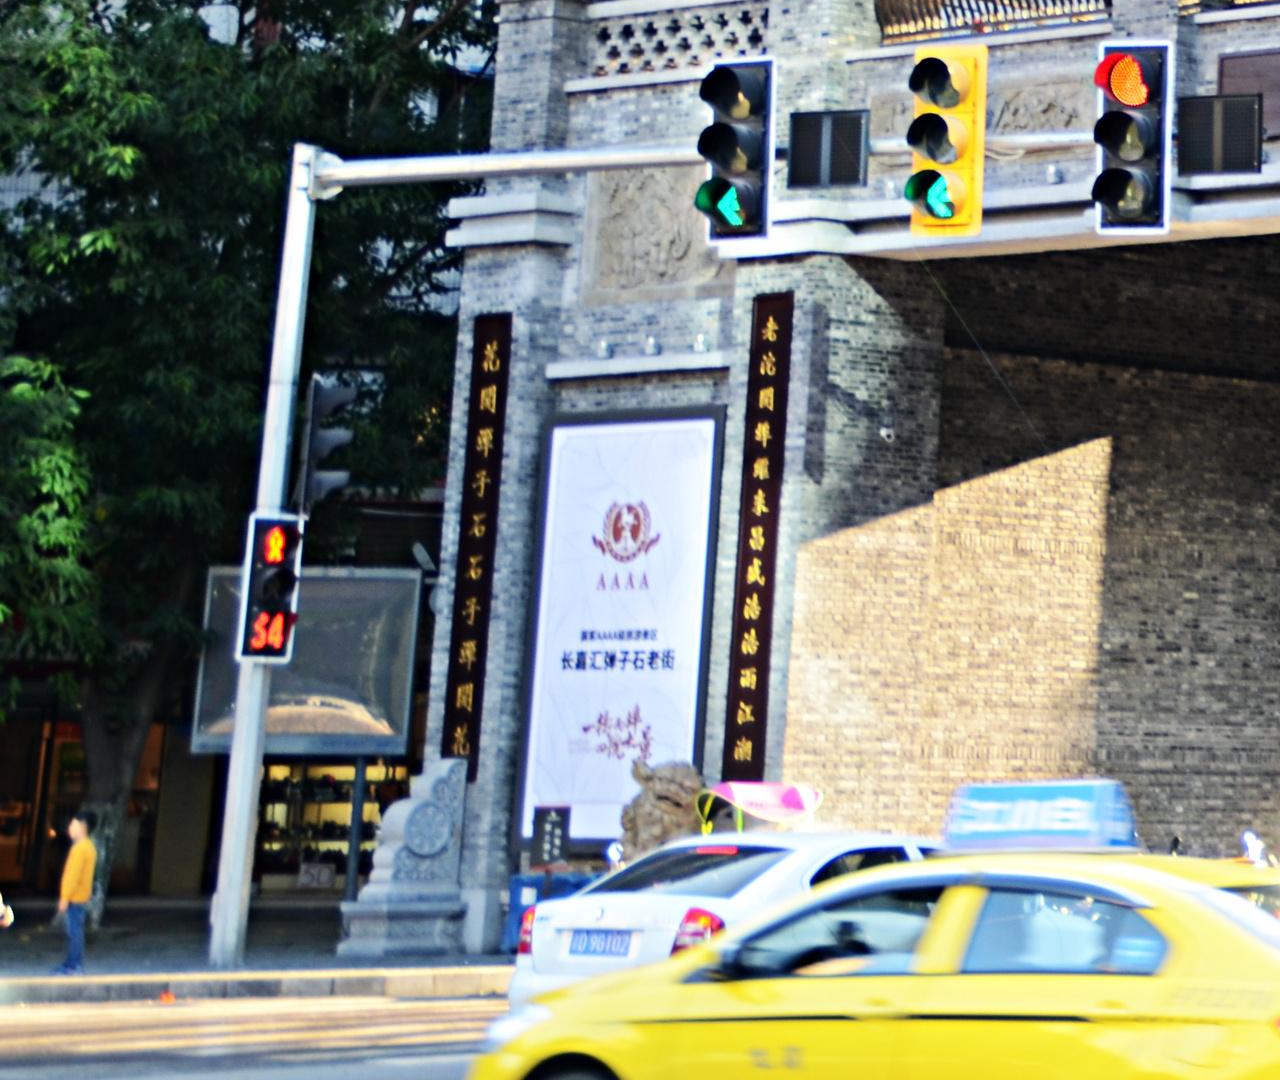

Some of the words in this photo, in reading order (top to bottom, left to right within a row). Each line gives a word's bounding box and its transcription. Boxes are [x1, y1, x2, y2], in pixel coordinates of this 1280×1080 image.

[561, 650, 676, 671] 长嘉汇弹子石老街
